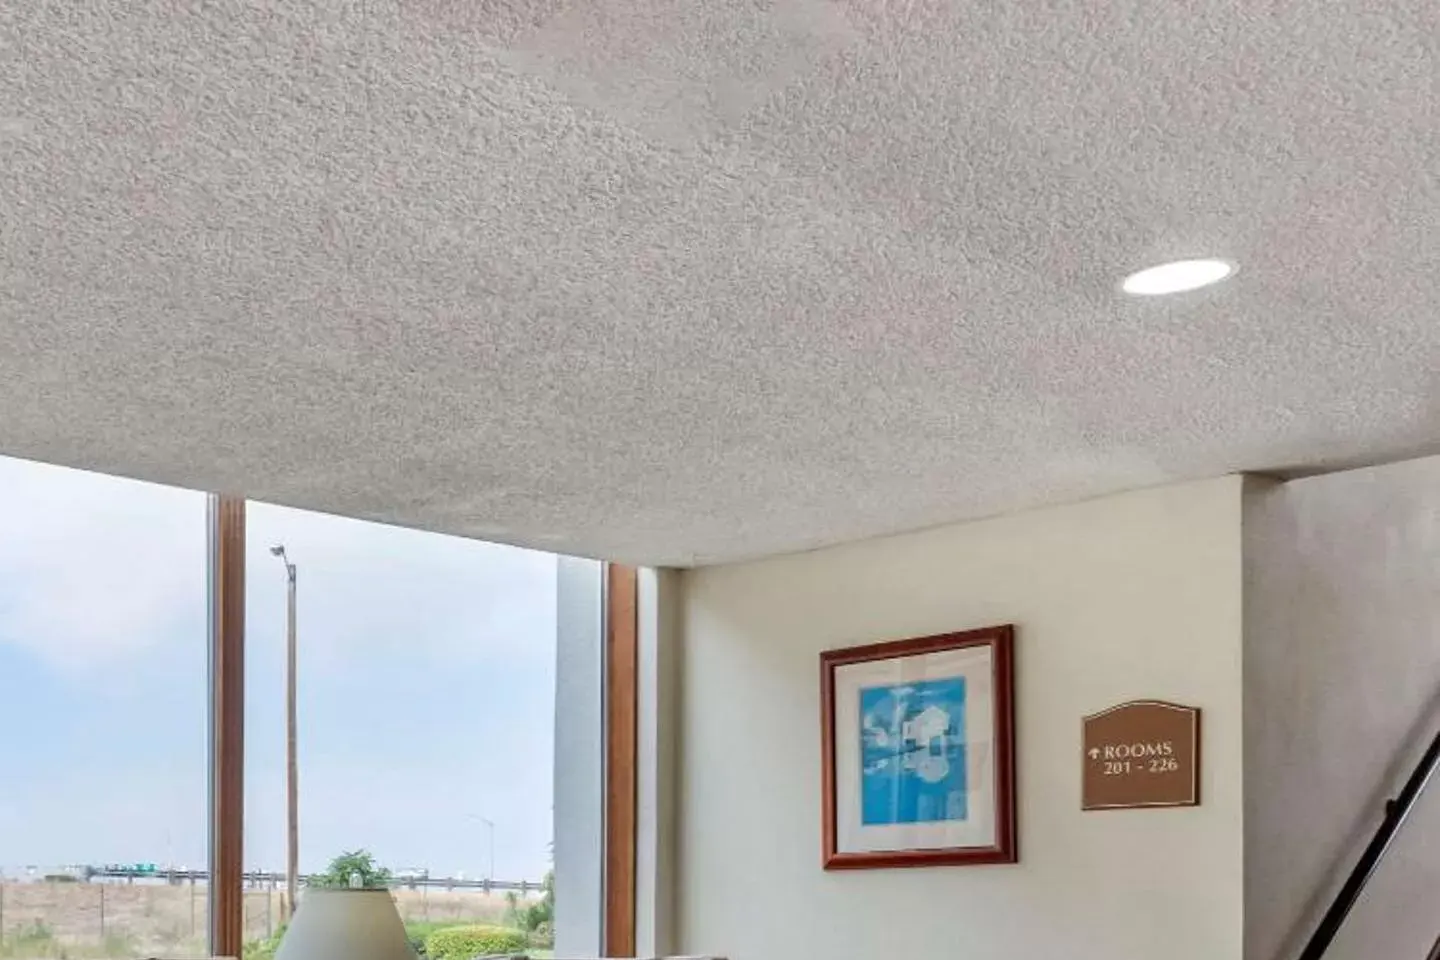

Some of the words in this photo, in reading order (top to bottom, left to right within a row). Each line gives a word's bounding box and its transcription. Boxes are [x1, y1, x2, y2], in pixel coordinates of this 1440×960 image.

[1104, 741, 1172, 759] ROOMS
[1104, 761, 1130, 775] 201
[1149, 758, 1178, 772] 226
